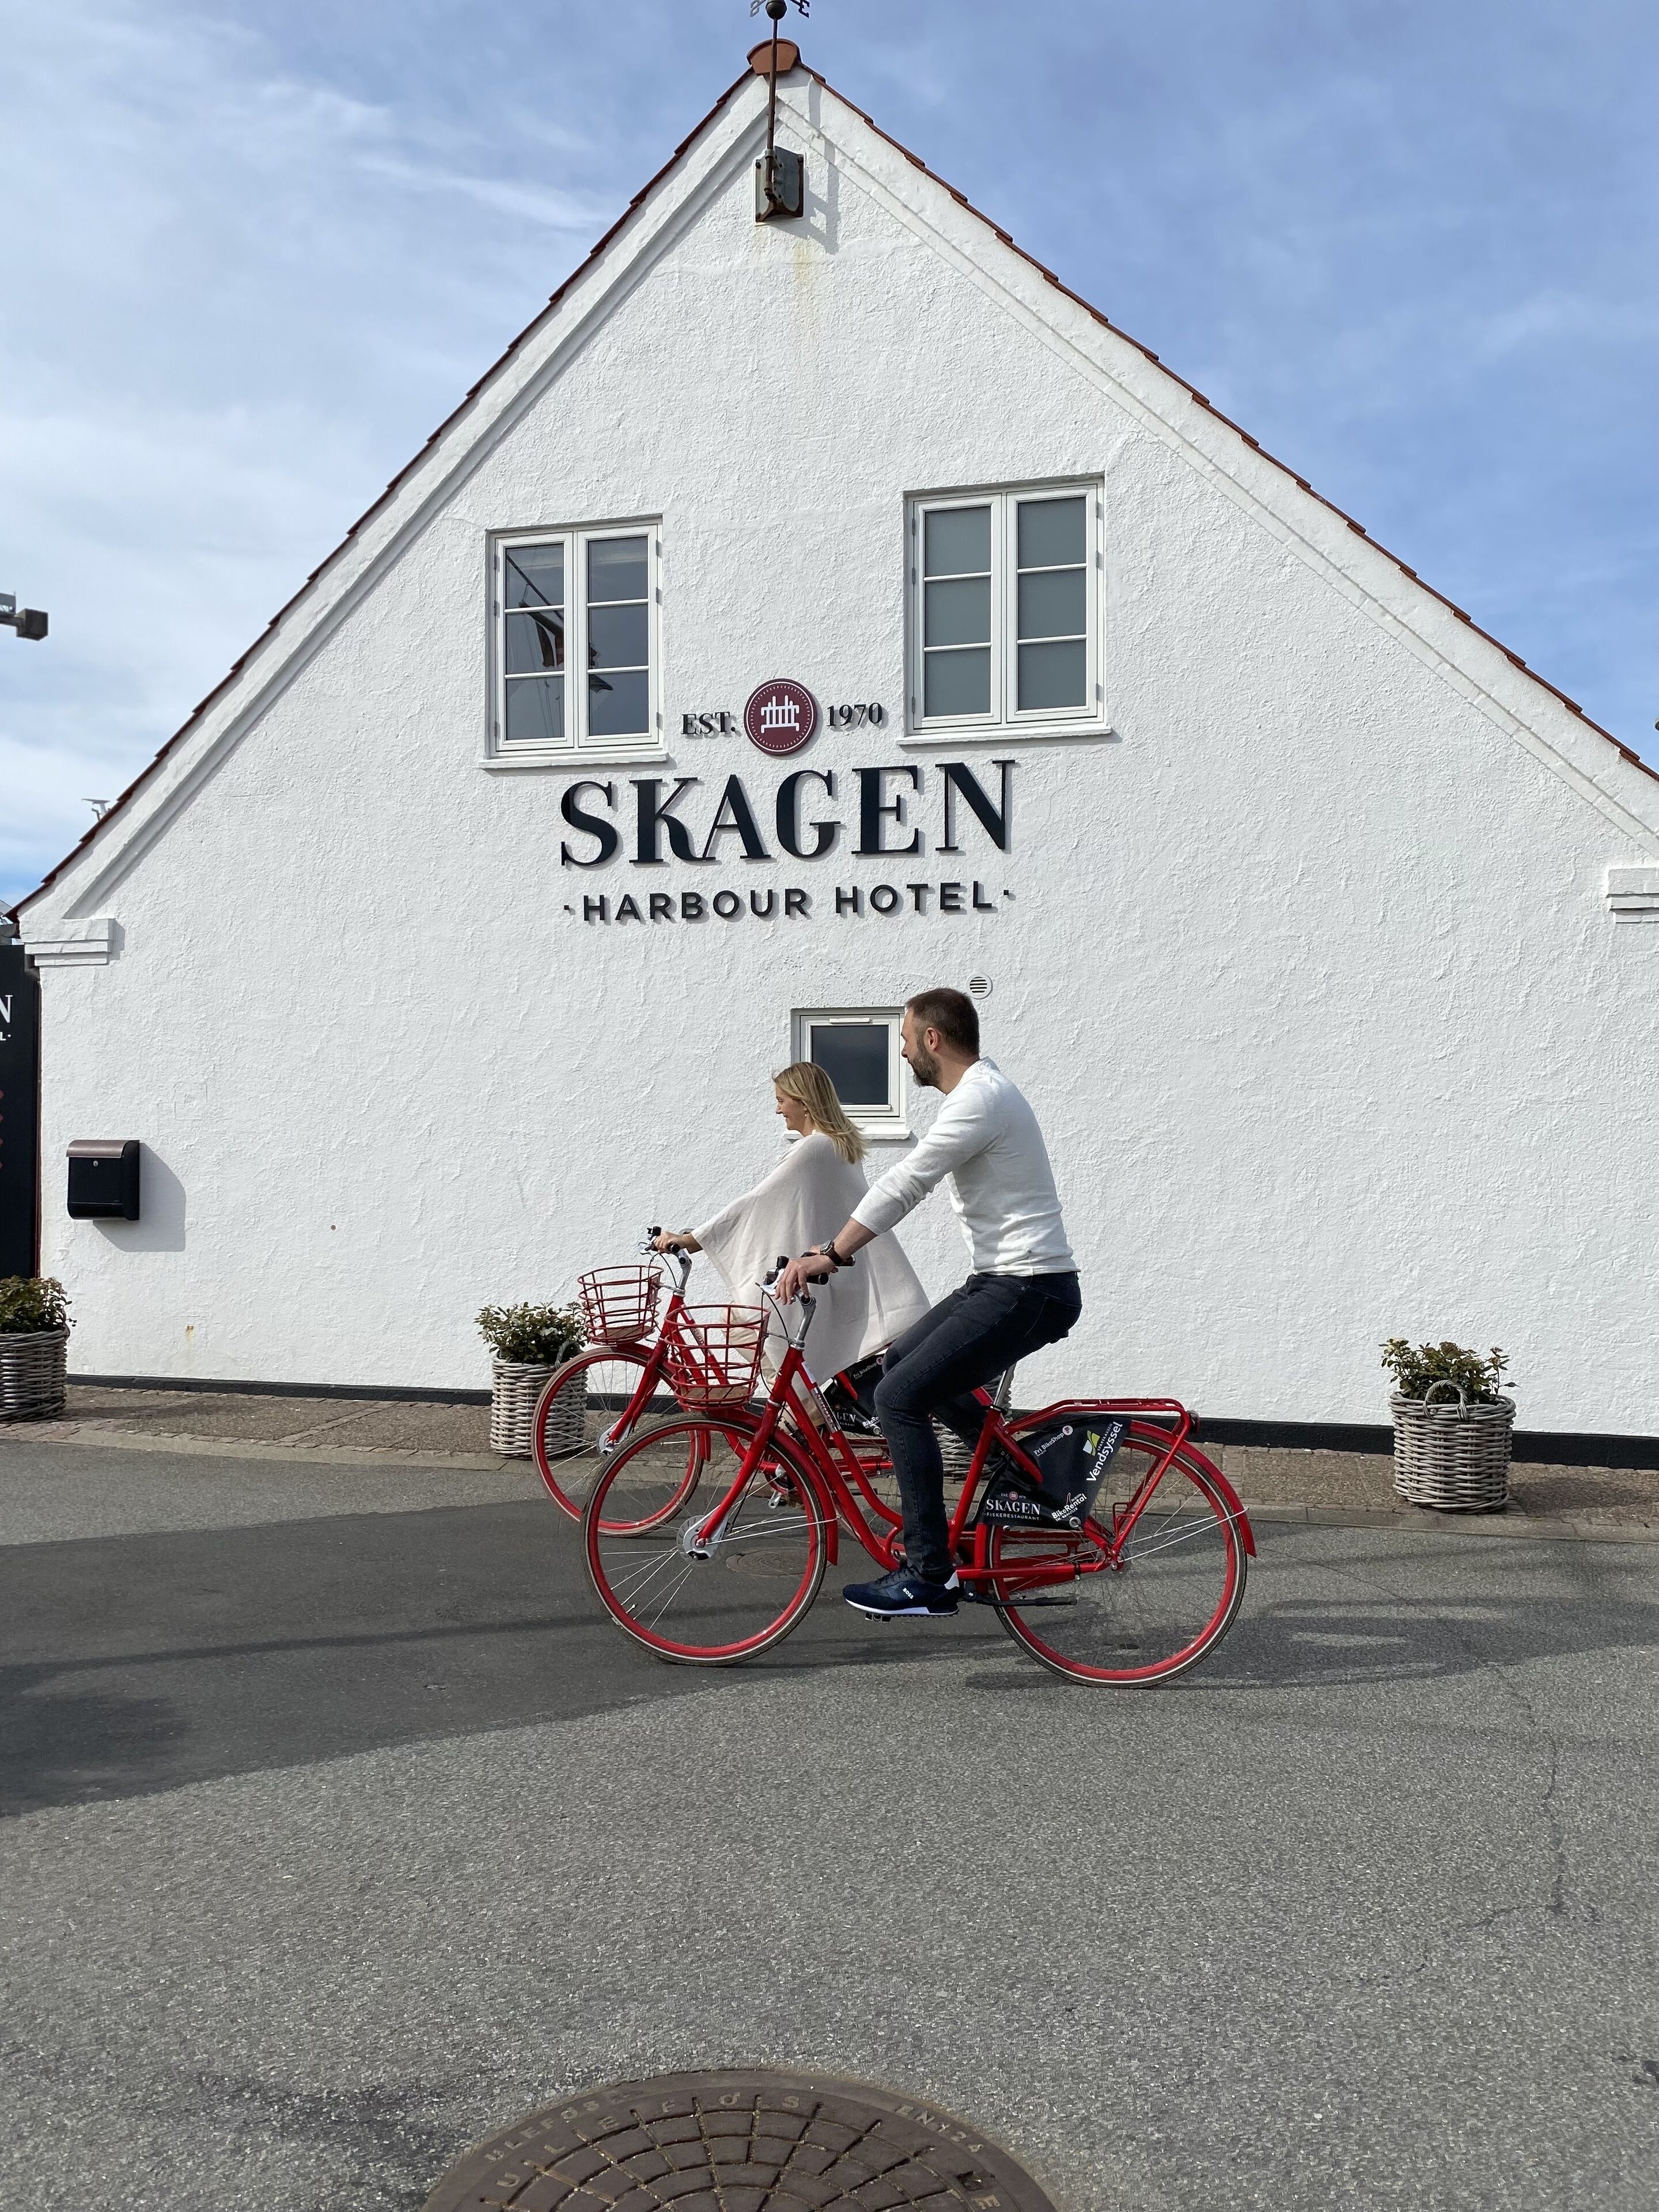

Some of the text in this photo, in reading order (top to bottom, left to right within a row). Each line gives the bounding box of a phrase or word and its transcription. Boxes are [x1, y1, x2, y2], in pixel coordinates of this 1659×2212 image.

[681, 702, 883, 735] EST. 1970
[560, 759, 1016, 866] SKAGEN
[583, 880, 993, 922] HARBOUR HOTEL
[1041, 1433, 1065, 1450] BikeShop
[1086, 1421, 1123, 1481] Vendsyssel
[986, 1499, 1041, 1515] SKAGEN
[986, 1512, 1040, 1521] FISKERESTAURANT
[1051, 1493, 1088, 1519] BikeRental
[903, 1588, 914, 1599] BOSS
